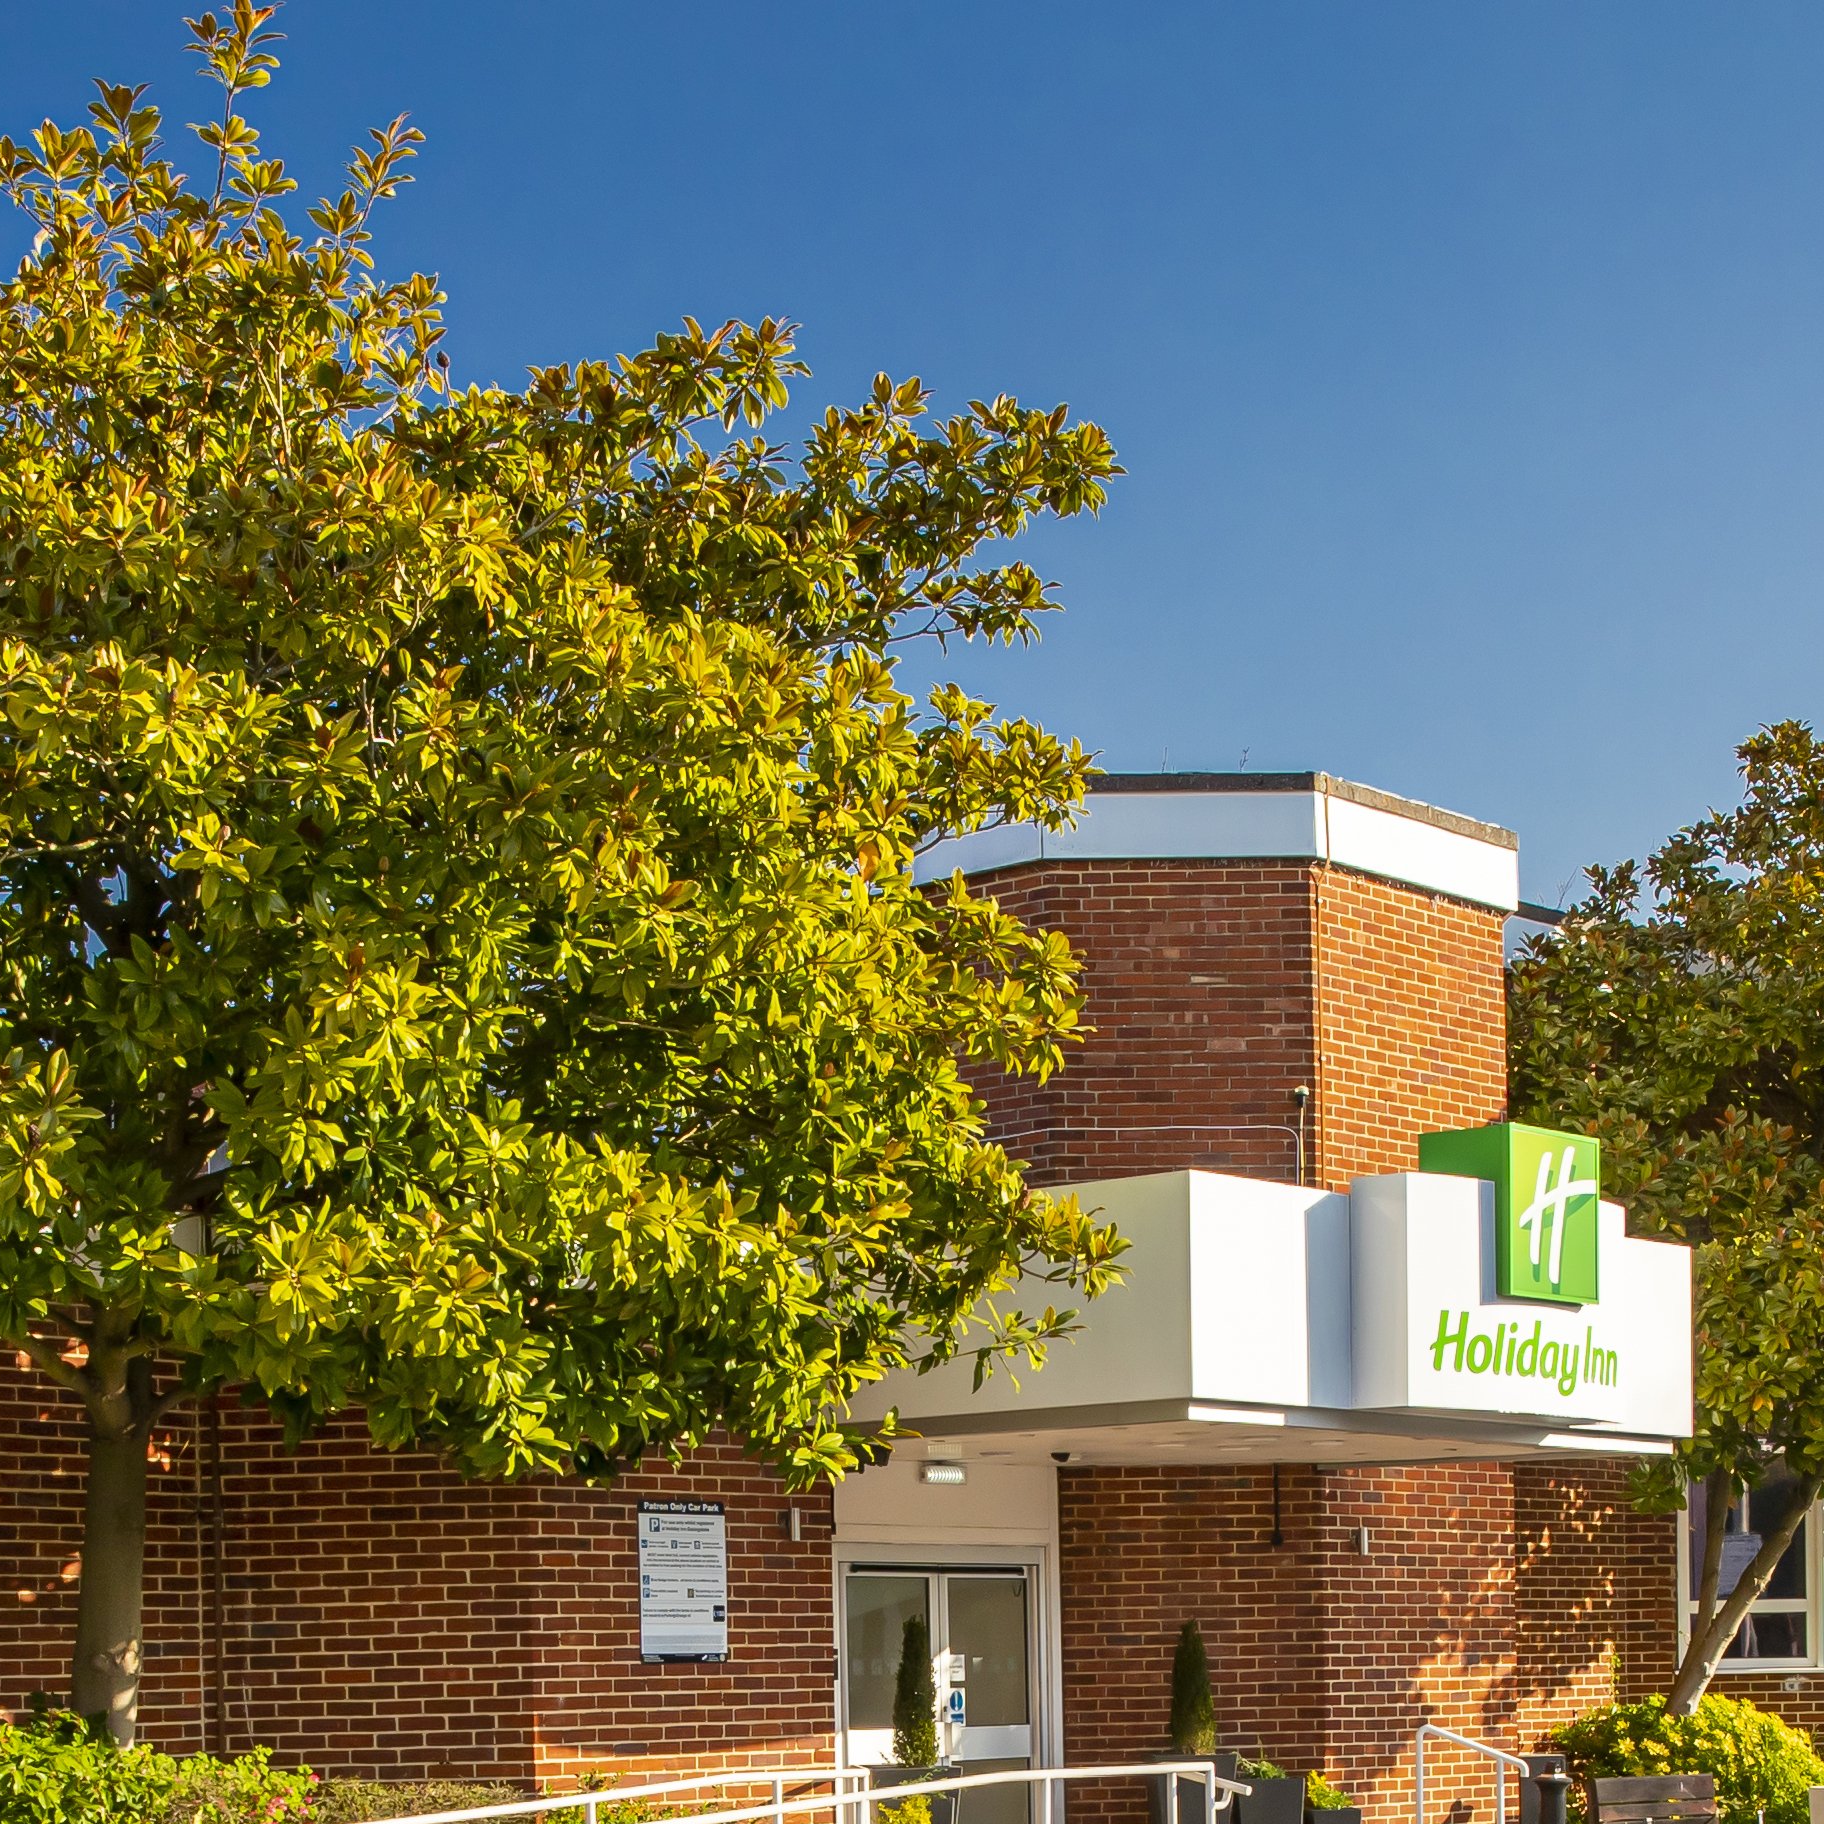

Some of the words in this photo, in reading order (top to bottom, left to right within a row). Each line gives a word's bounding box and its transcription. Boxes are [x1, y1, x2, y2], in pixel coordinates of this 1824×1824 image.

[1429, 1310, 1579, 1396] Holiday
[1583, 1325, 1618, 1387] Inn
[643, 1501, 669, 1510] Patron
[670, 1502, 687, 1513] Only
[688, 1503, 701, 1512] Car
[702, 1503, 720, 1512] Park
